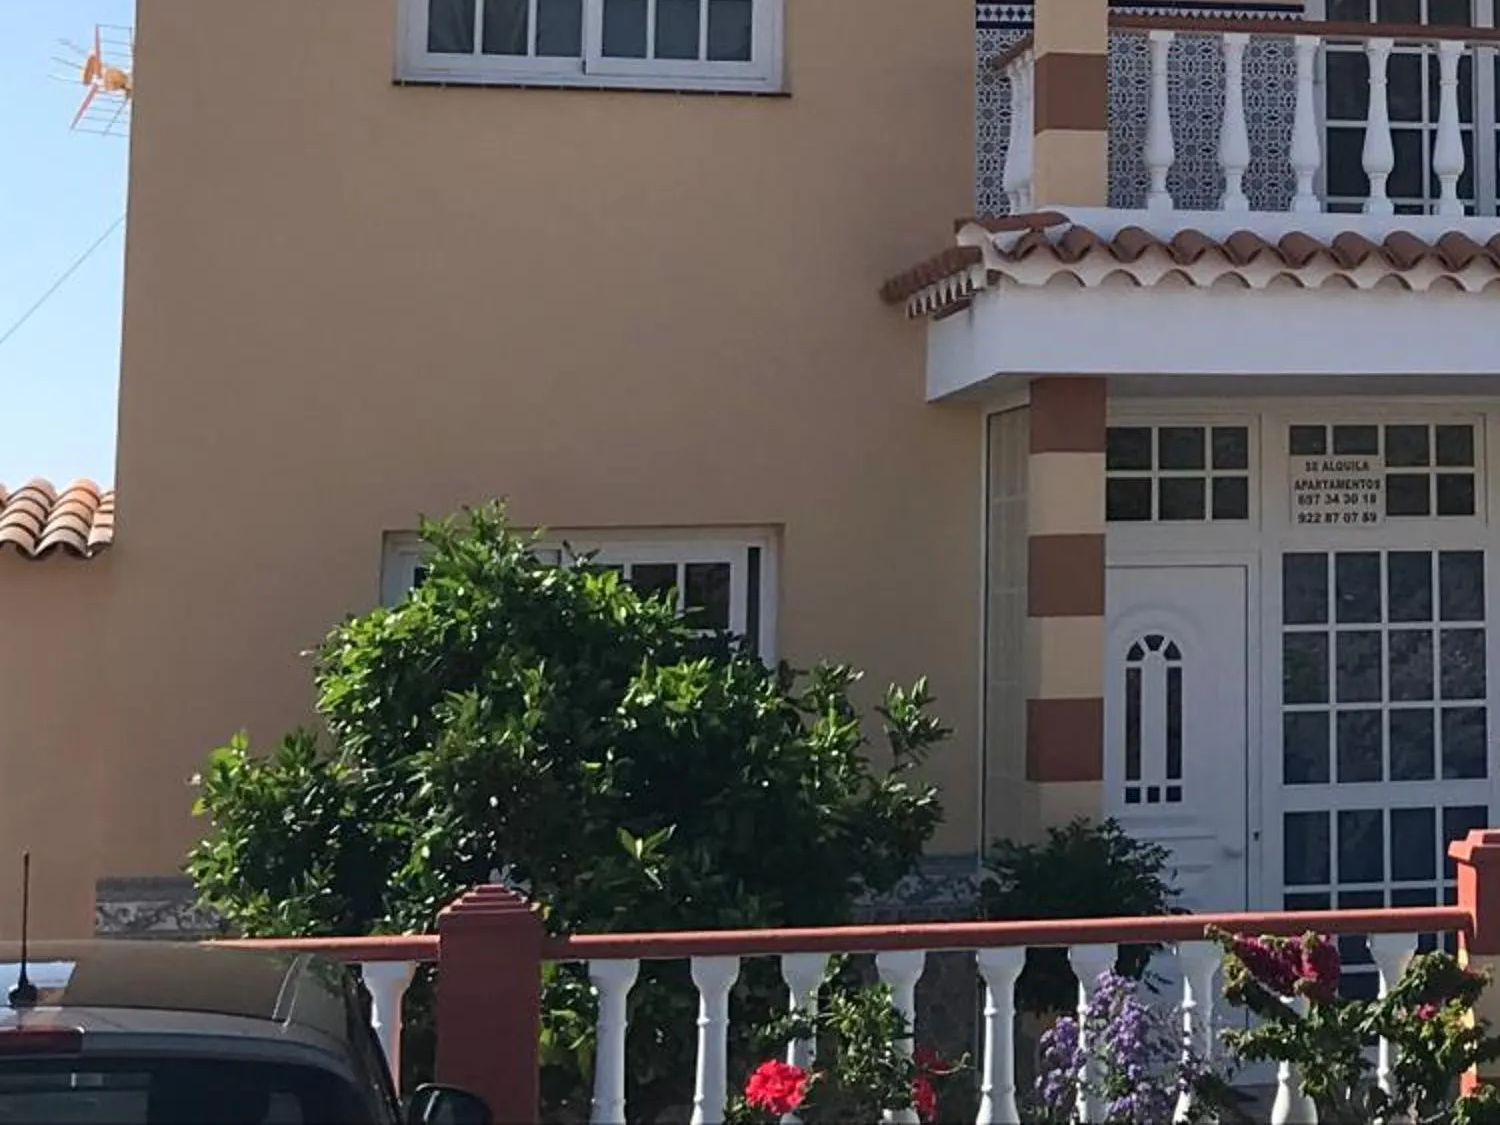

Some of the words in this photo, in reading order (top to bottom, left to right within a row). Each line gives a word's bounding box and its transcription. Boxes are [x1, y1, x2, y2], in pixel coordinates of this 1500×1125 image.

[1305, 461, 1318, 472] SE
[1322, 460, 1370, 472] ALQUILA
[1294, 478, 1380, 491] APARTAMENTOS
[1297, 511, 1321, 524] 922
[1324, 511, 1340, 524] 87
[1343, 511, 1359, 524] 07
